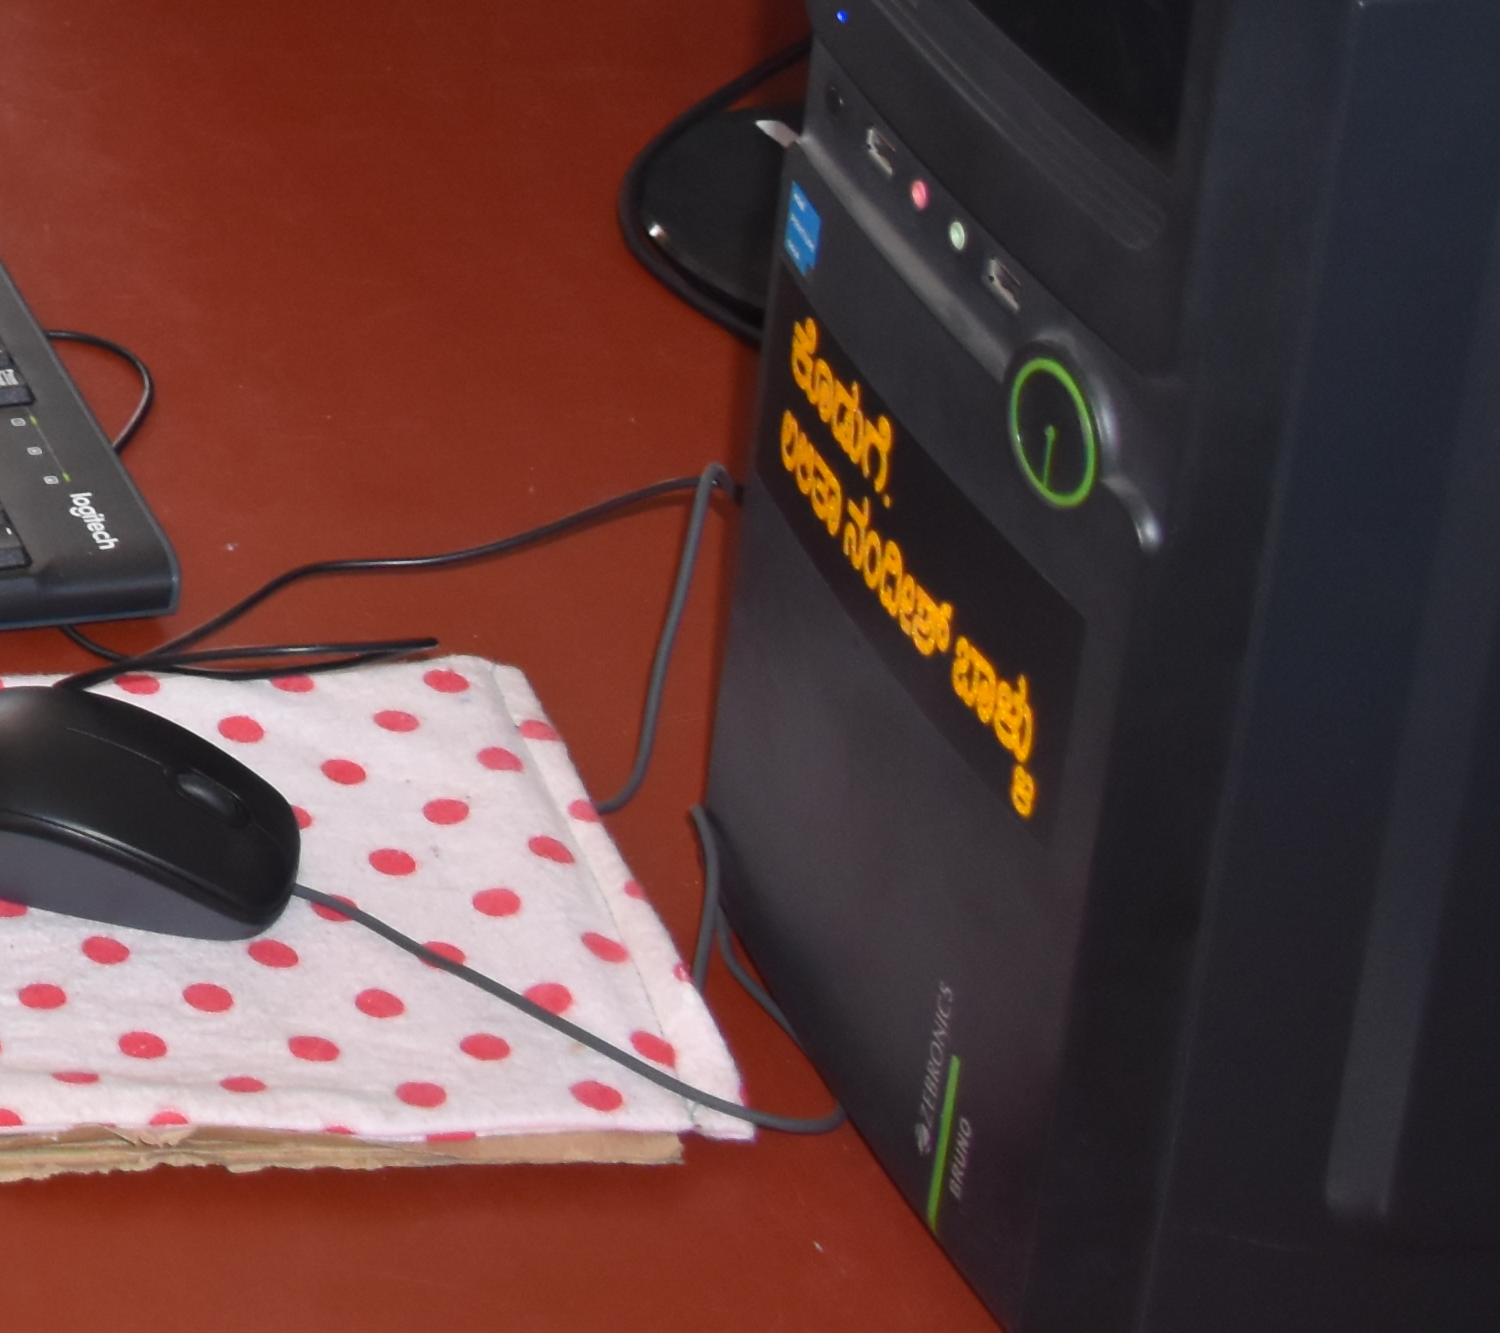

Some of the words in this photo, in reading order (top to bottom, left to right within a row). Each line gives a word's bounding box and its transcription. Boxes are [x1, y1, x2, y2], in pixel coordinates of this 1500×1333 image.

[69, 492, 119, 550] logitech
[919, 981, 953, 1129] ZEBRONICS
[949, 1116, 972, 1201] BRUNO
